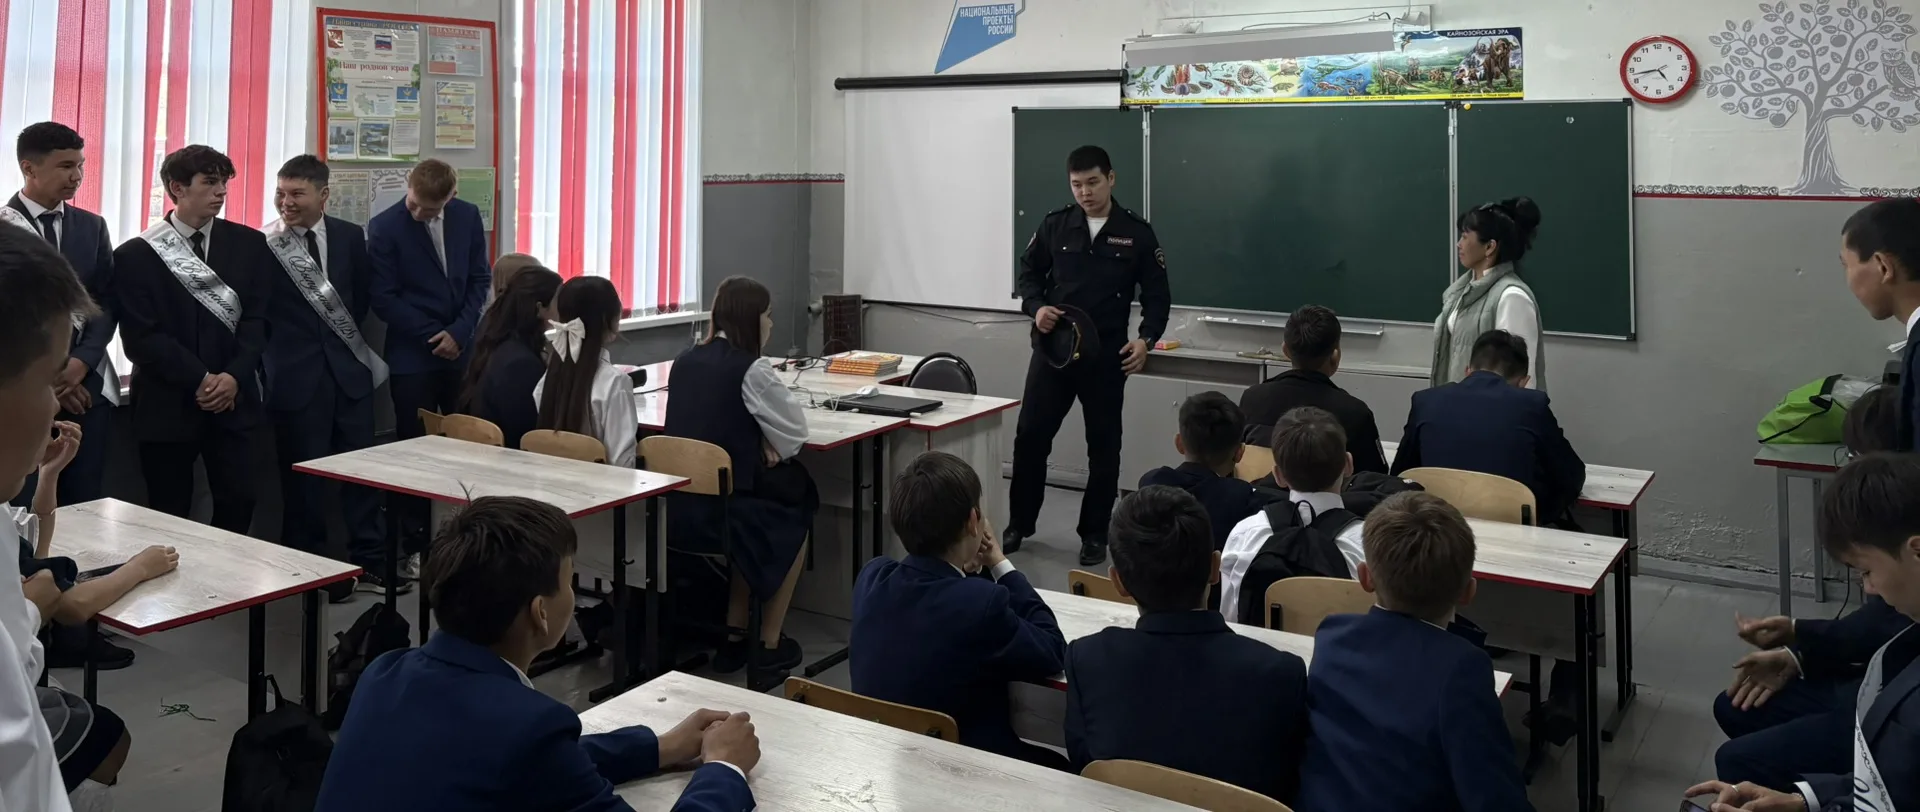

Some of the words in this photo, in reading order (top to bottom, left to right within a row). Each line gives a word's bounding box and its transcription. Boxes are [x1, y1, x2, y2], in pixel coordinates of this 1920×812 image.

[960, 5, 1014, 17] НАЦИОНАЛЬНЫЕ
[982, 15, 1013, 26] ПРОЕКТЫ
[987, 25, 1013, 35] РОССИИ
[339, 61, 357, 69] Наш
[360, 64, 388, 72] родной
[174, 257, 237, 318] Выпускник
[288, 255, 336, 318] Выпускник
